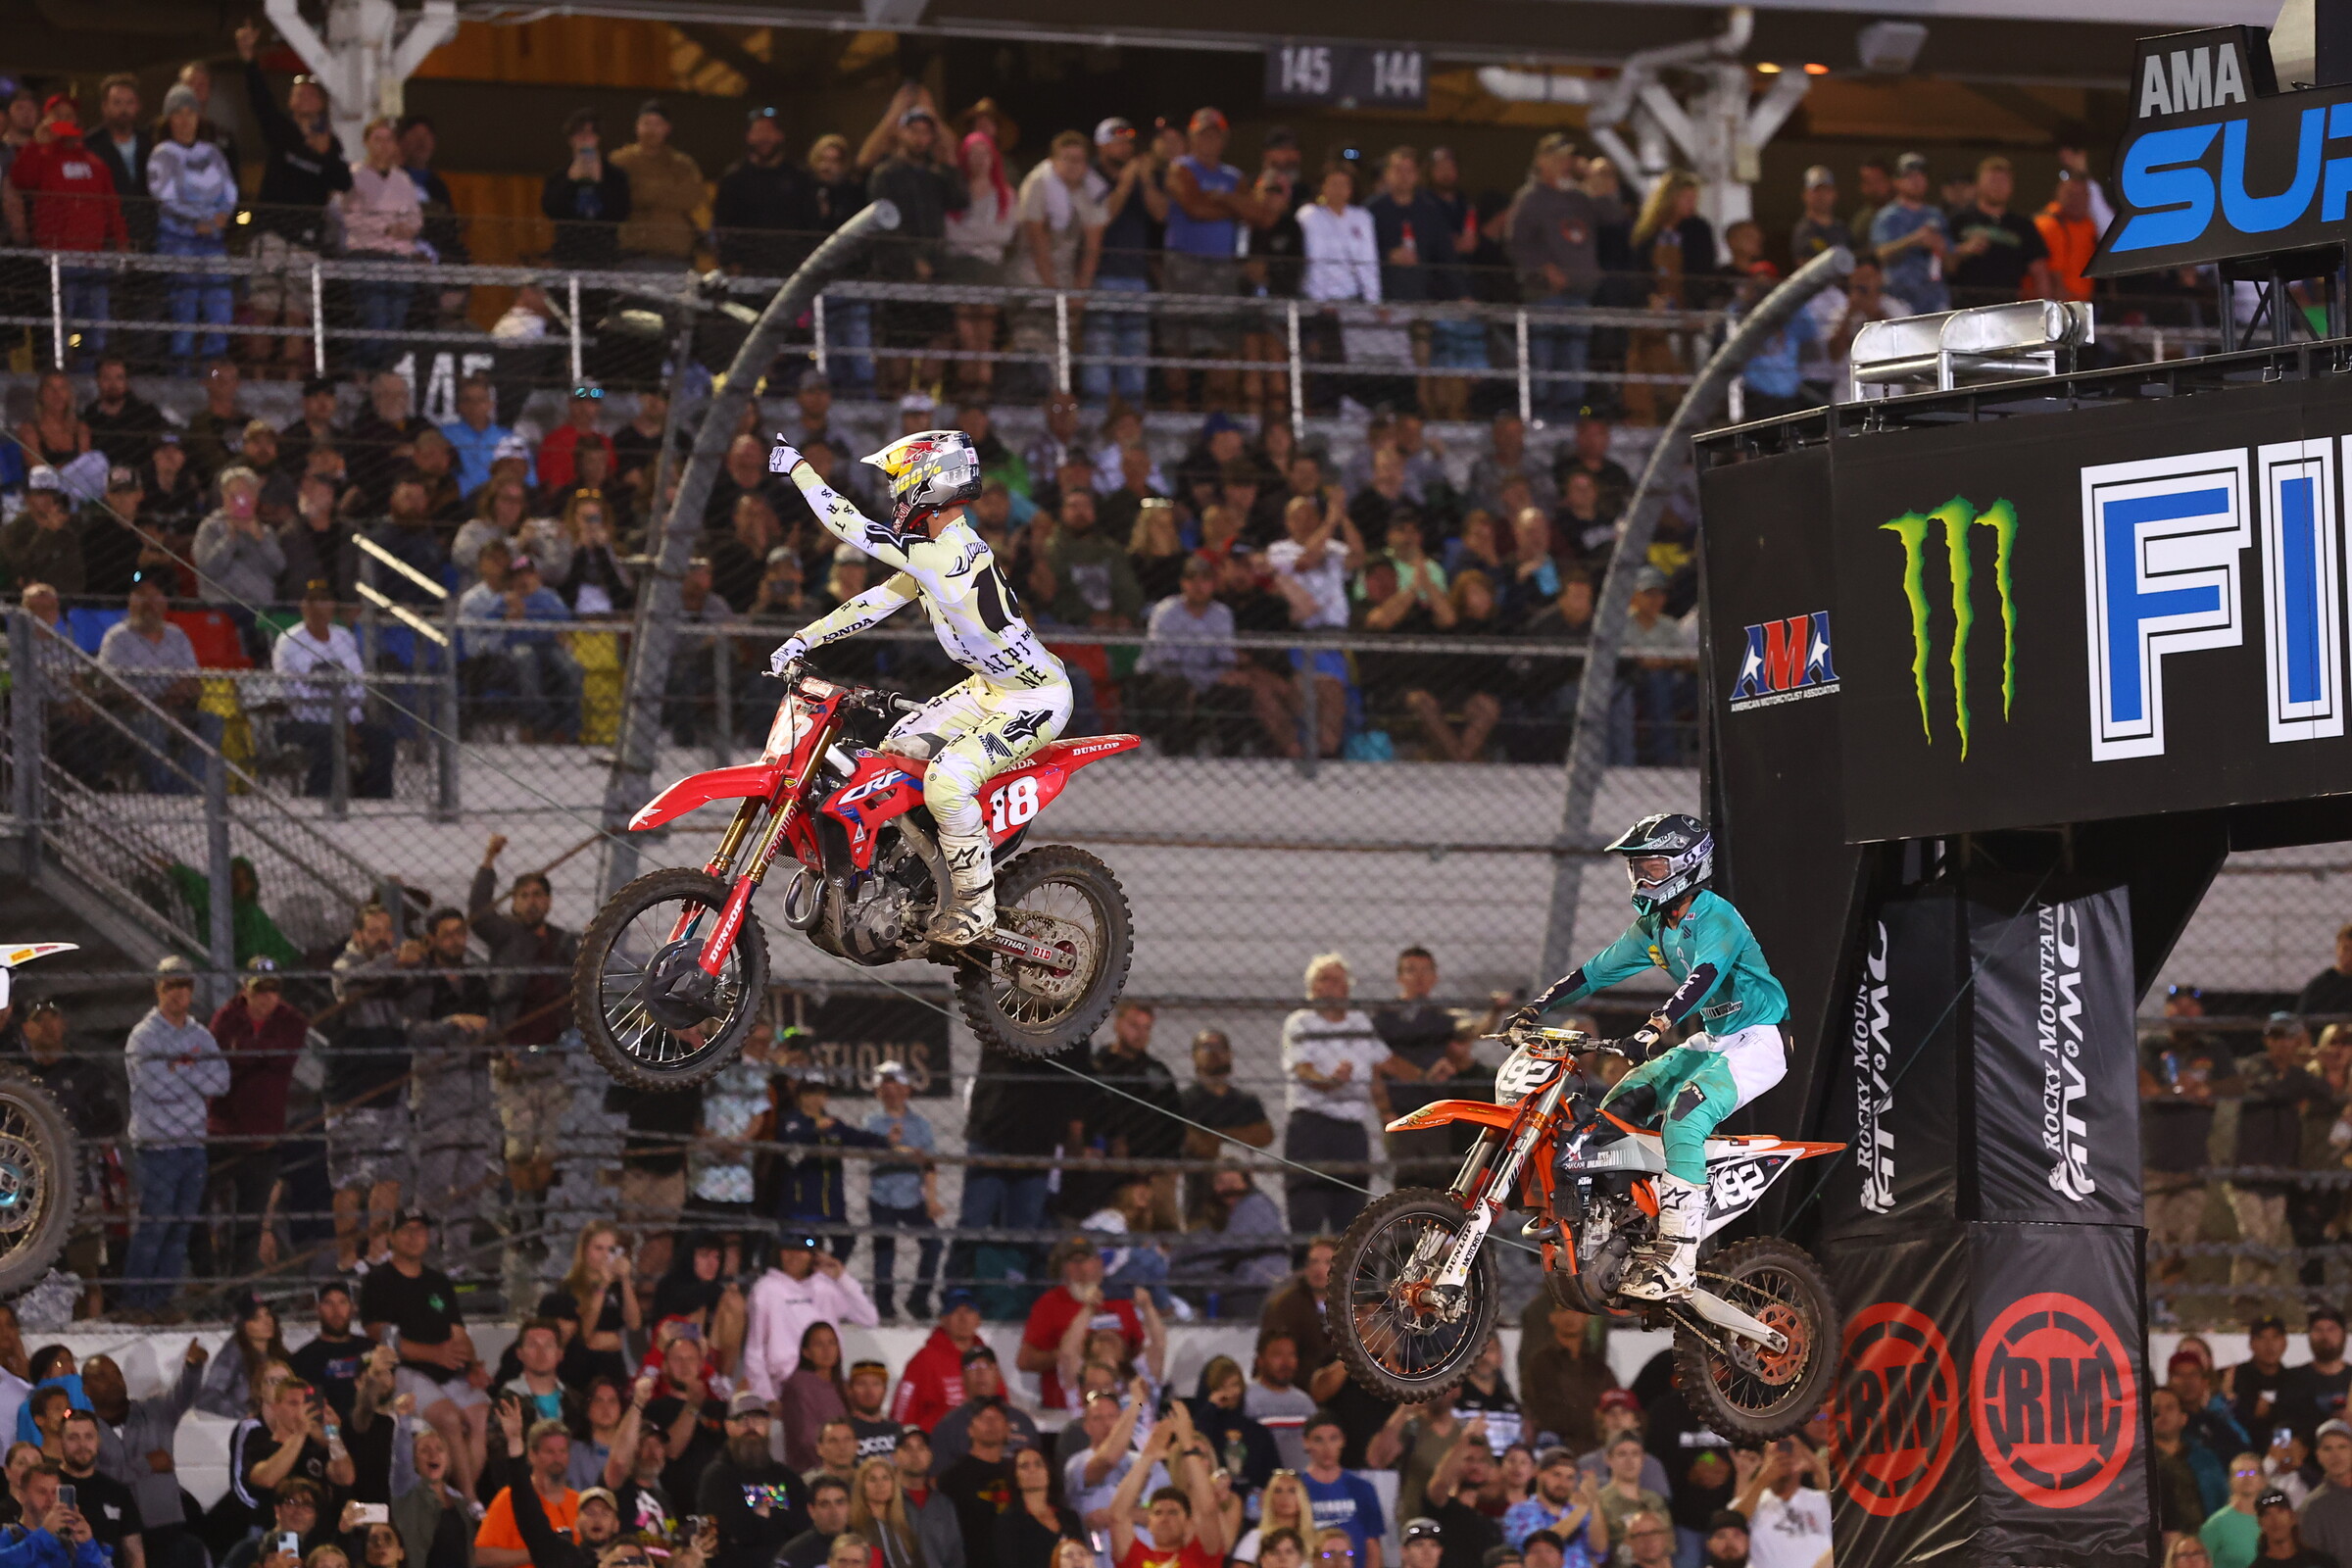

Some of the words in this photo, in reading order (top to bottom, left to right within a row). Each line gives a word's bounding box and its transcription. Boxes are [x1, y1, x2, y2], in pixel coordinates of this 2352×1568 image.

[1280, 47, 1331, 94] 145
[1373, 51, 1421, 97] 144
[2139, 42, 2247, 119] AMA
[894, 459, 942, 494] 100%
[2080, 433, 2352, 762] FI
[1729, 610, 1840, 702] AMA
[1731, 699, 1761, 712] AMERICAN
[1761, 691, 1803, 707] MOTORCYCLIST
[1803, 684, 1840, 699] ASSOCIATION
[978, 734, 997, 766] HONDA
[998, 758, 1038, 773] ONDA
[1072, 742, 1120, 757] DUNLOP
[837, 769, 904, 806] CRF
[989, 775, 1040, 834] 18
[709, 898, 743, 964] DUNLOP
[991, 934, 1029, 953] ENTHAL
[1032, 946, 1053, 960] DID
[2036, 901, 2059, 1059] MOUNTAIN
[1852, 970, 1871, 1074] MOUN
[1497, 1058, 1559, 1095] 92
[1856, 1076, 1874, 1171] ROCKY
[2041, 1060, 2061, 1155] ROCKY
[1578, 1176, 1592, 1186] KTM
[1713, 1159, 1765, 1211] 192
[1461, 1229, 1486, 1268] MOTOREX
[1847, 1364, 1933, 1456] RM
[2003, 1356, 2103, 1446] RM
